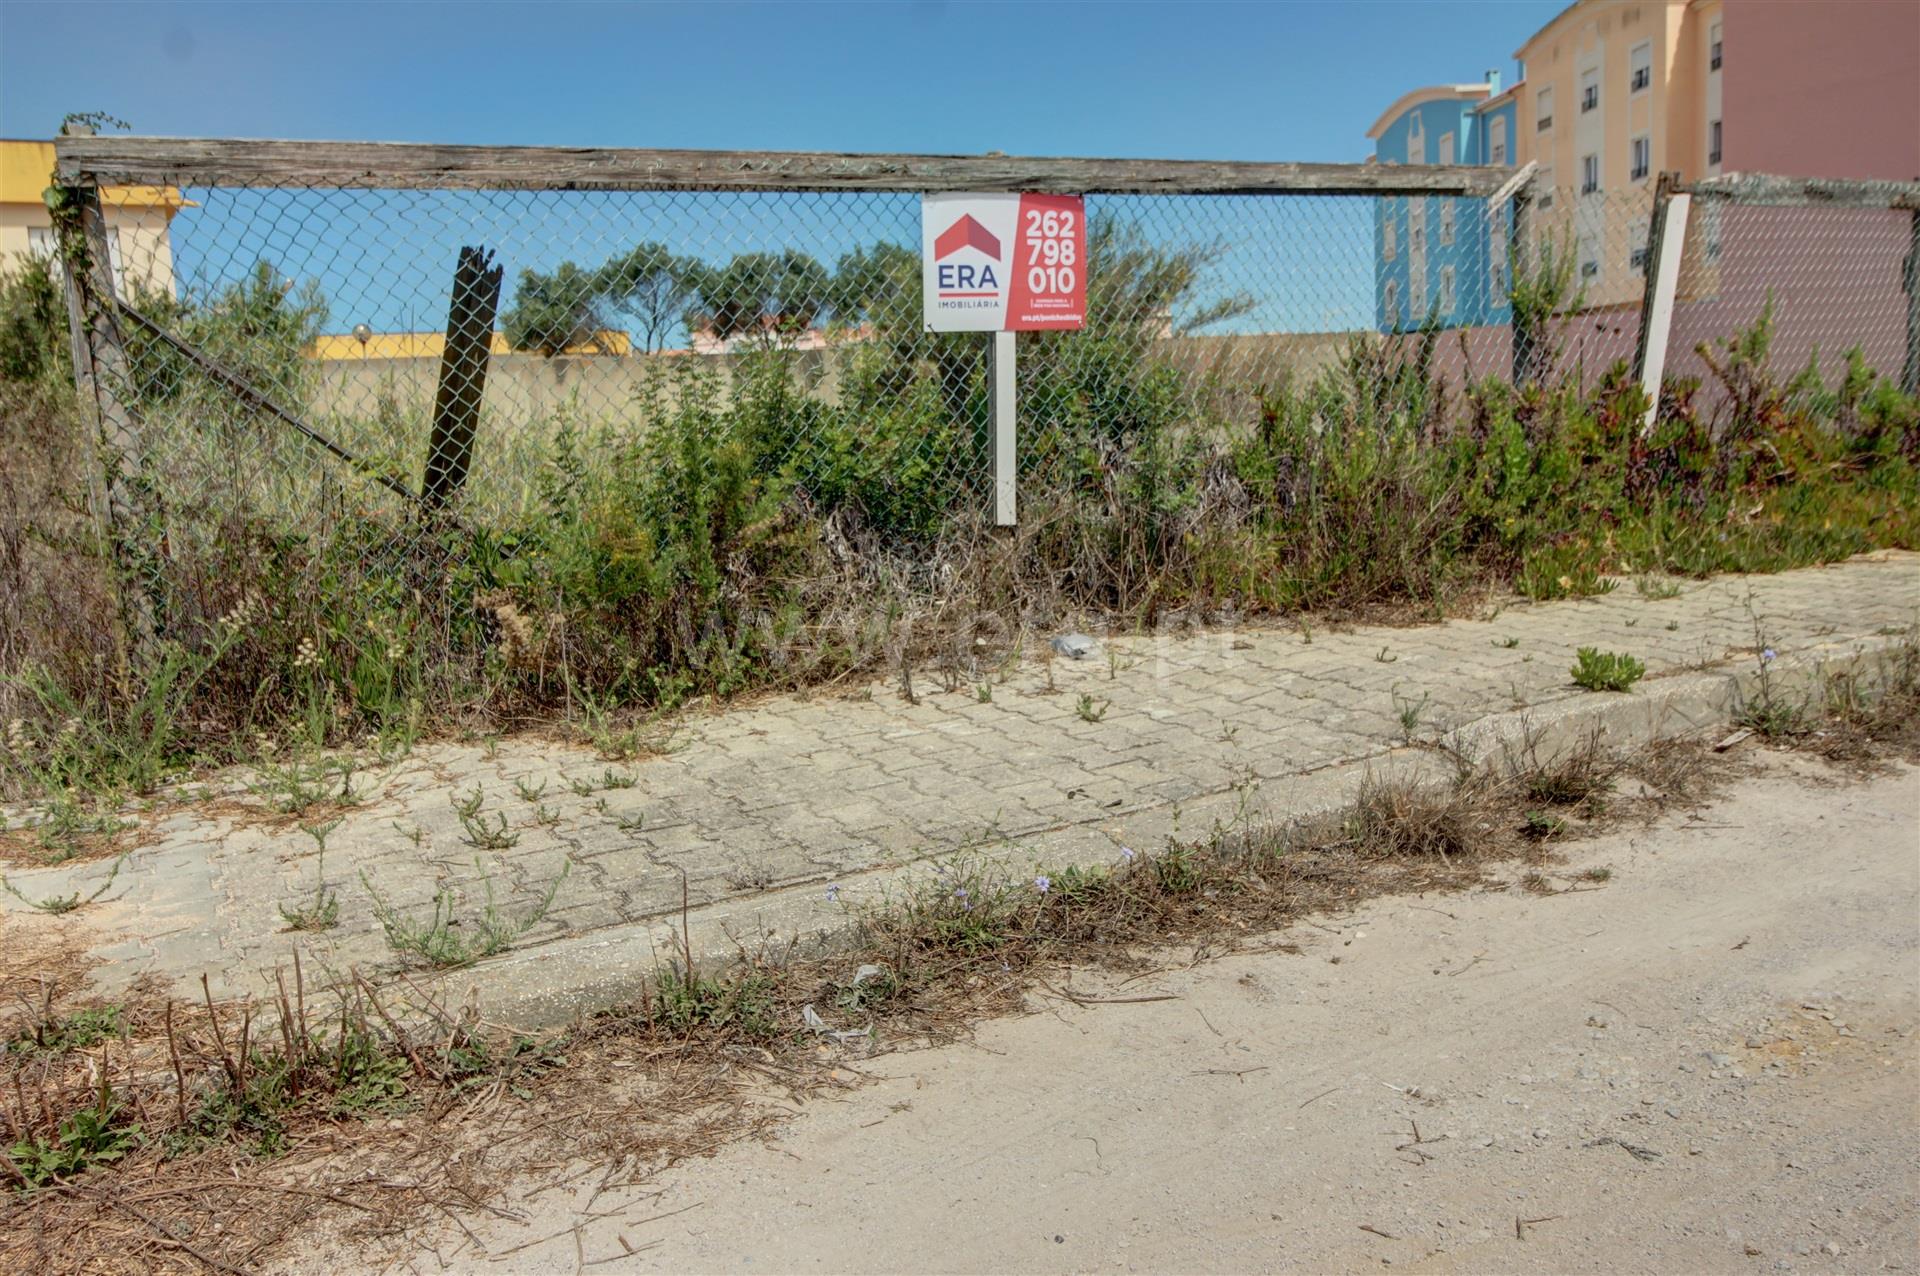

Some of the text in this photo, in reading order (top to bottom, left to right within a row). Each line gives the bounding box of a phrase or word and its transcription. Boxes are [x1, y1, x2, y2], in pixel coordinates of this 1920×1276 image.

[1027, 210, 1075, 237] 262
[1027, 239, 1075, 266] 798
[939, 265, 998, 288] ERA
[1028, 267, 1075, 294] 010
[939, 300, 999, 309] IMOBILIÁRIA
